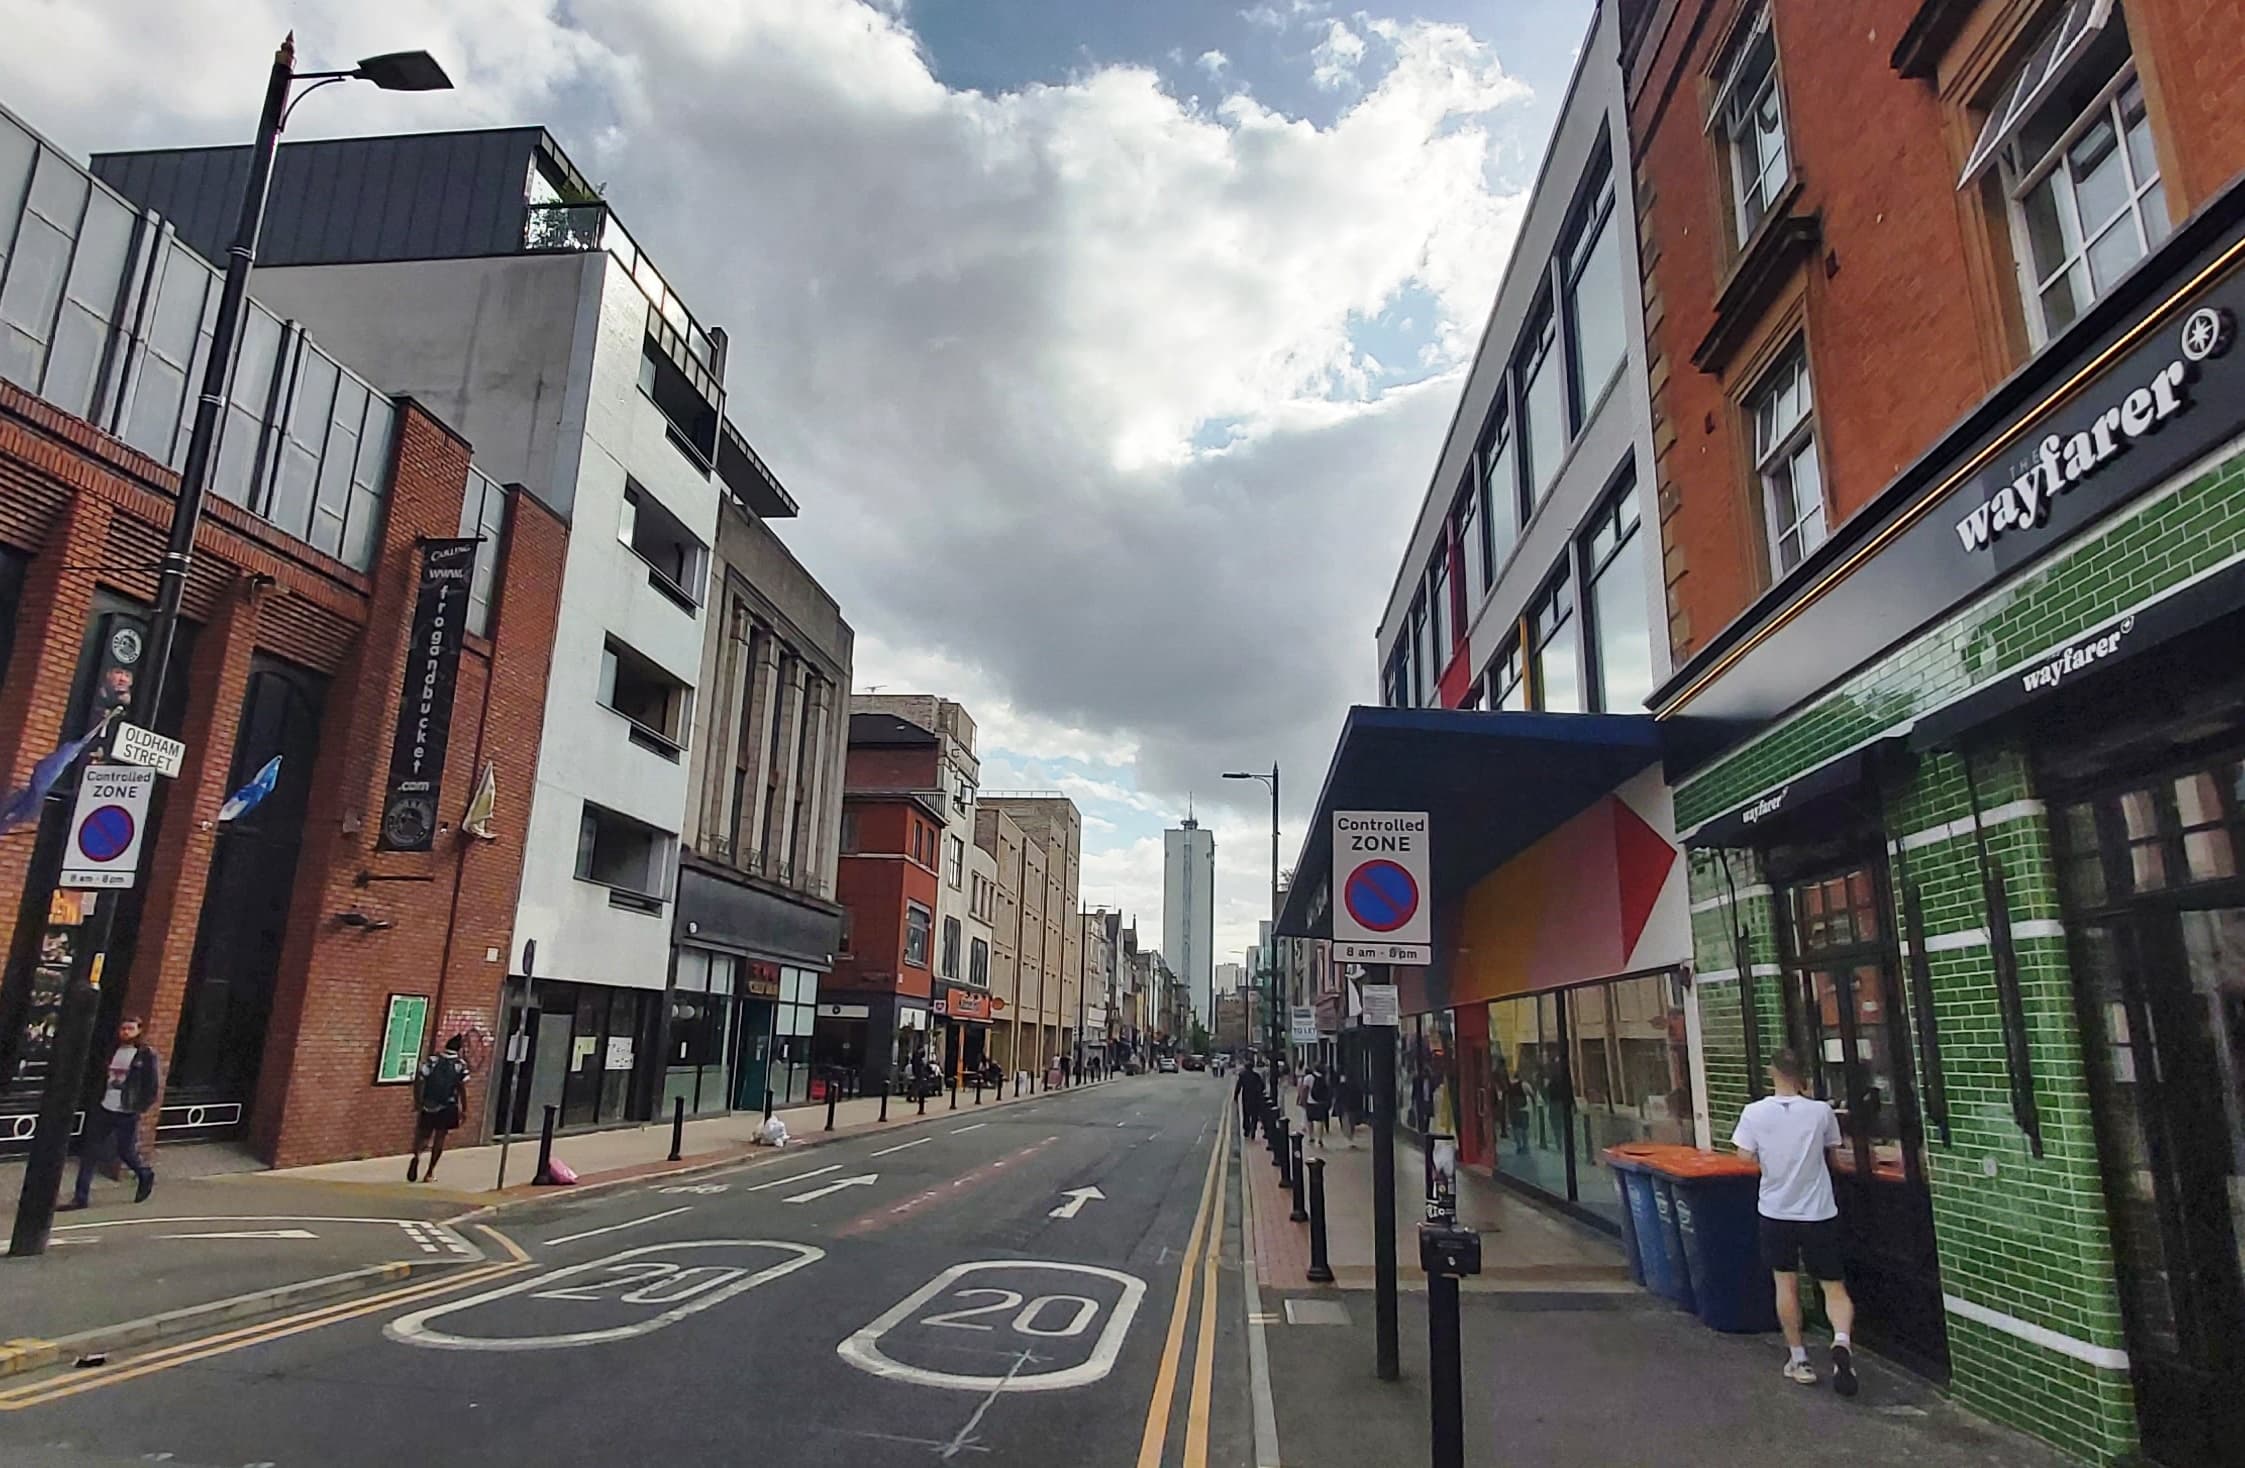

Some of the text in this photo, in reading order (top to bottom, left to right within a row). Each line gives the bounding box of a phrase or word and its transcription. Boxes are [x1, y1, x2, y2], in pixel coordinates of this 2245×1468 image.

[1955, 360, 2185, 552] wayfarer
[2022, 631, 2121, 692] wayfarer
[413, 585, 449, 775] frogandbucket
[125, 727, 181, 758] OLDHAM
[123, 743, 174, 771] STREET
[87, 770, 152, 783] Controlled
[92, 785, 139, 799] ZONE
[1742, 796, 1782, 823] wayfarer
[1338, 817, 1425, 832] Controlled
[1351, 835, 1412, 852] ZONE
[1346, 946, 1354, 957] 8
[1358, 948, 1376, 958] am
[1293, 1027, 1303, 1035] TO
[529, 1263, 749, 1303] 20
[919, 1287, 1101, 1337] 20
